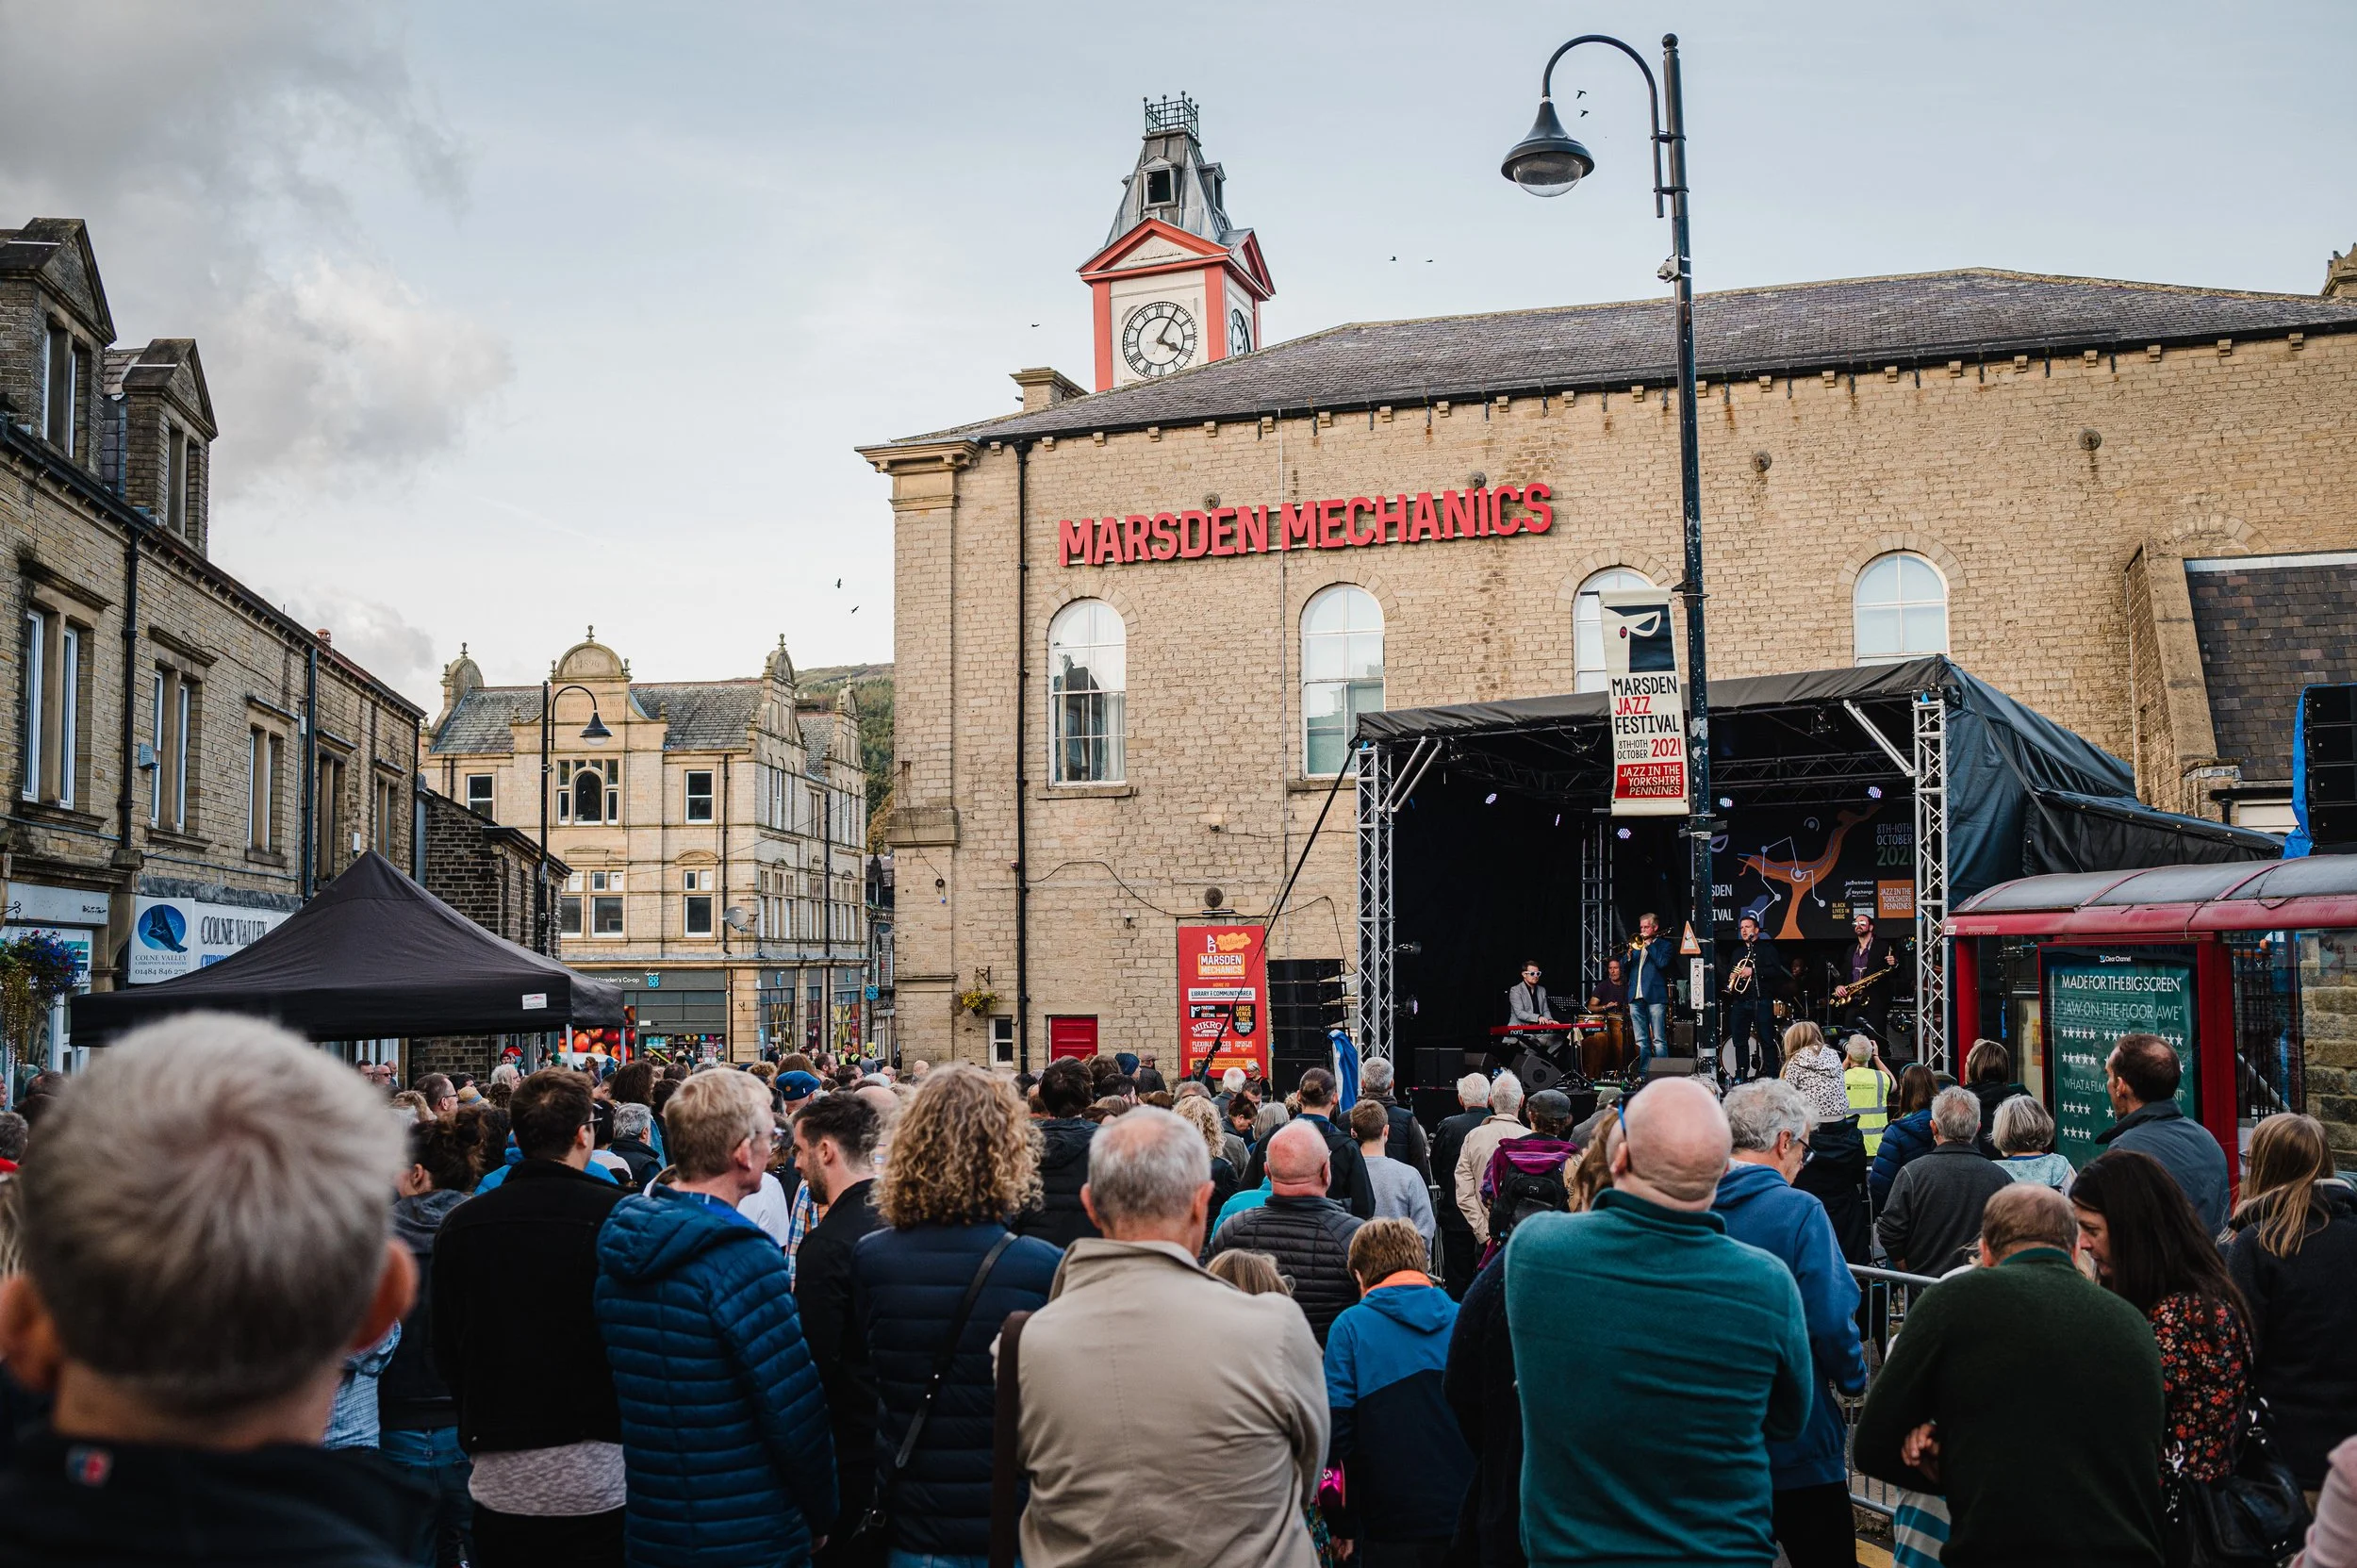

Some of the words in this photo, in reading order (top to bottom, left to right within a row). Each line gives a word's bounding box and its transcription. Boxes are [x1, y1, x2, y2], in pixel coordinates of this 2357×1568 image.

[1060, 504, 1268, 566] MARSDEN
[1280, 483, 1552, 551] MECHANICS
[1612, 676, 1677, 696] MARSDEN
[1615, 696, 1652, 716] JAZZ
[1615, 714, 1680, 734] FESTIVAL
[1619, 739, 1648, 750] 8TH-10TH
[1651, 737, 1681, 757] 2021
[1617, 750, 1648, 759] OCTOBER
[1621, 767, 1646, 777] JAZZ
[1648, 766, 1660, 776] IN
[1663, 765, 1681, 775] THE
[1628, 775, 1681, 787] YORKSHIRE
[1629, 785, 1680, 796] PENNINES
[1877, 823, 1913, 834] 8TH-10TH
[1877, 834, 1913, 845] OCTOBER
[1877, 845, 1914, 866] 2021
[201, 916, 234, 945] COLNE
[1200, 955, 1242, 966] MARSDEN
[1200, 966, 1243, 975] MECHANICS
[2088, 976, 2106, 990] FOR
[2108, 976, 2125, 990] THE
[2125, 976, 2143, 991] BIG
[2085, 1081, 2090, 1091] A
[2090, 1081, 2106, 1093] FILM
